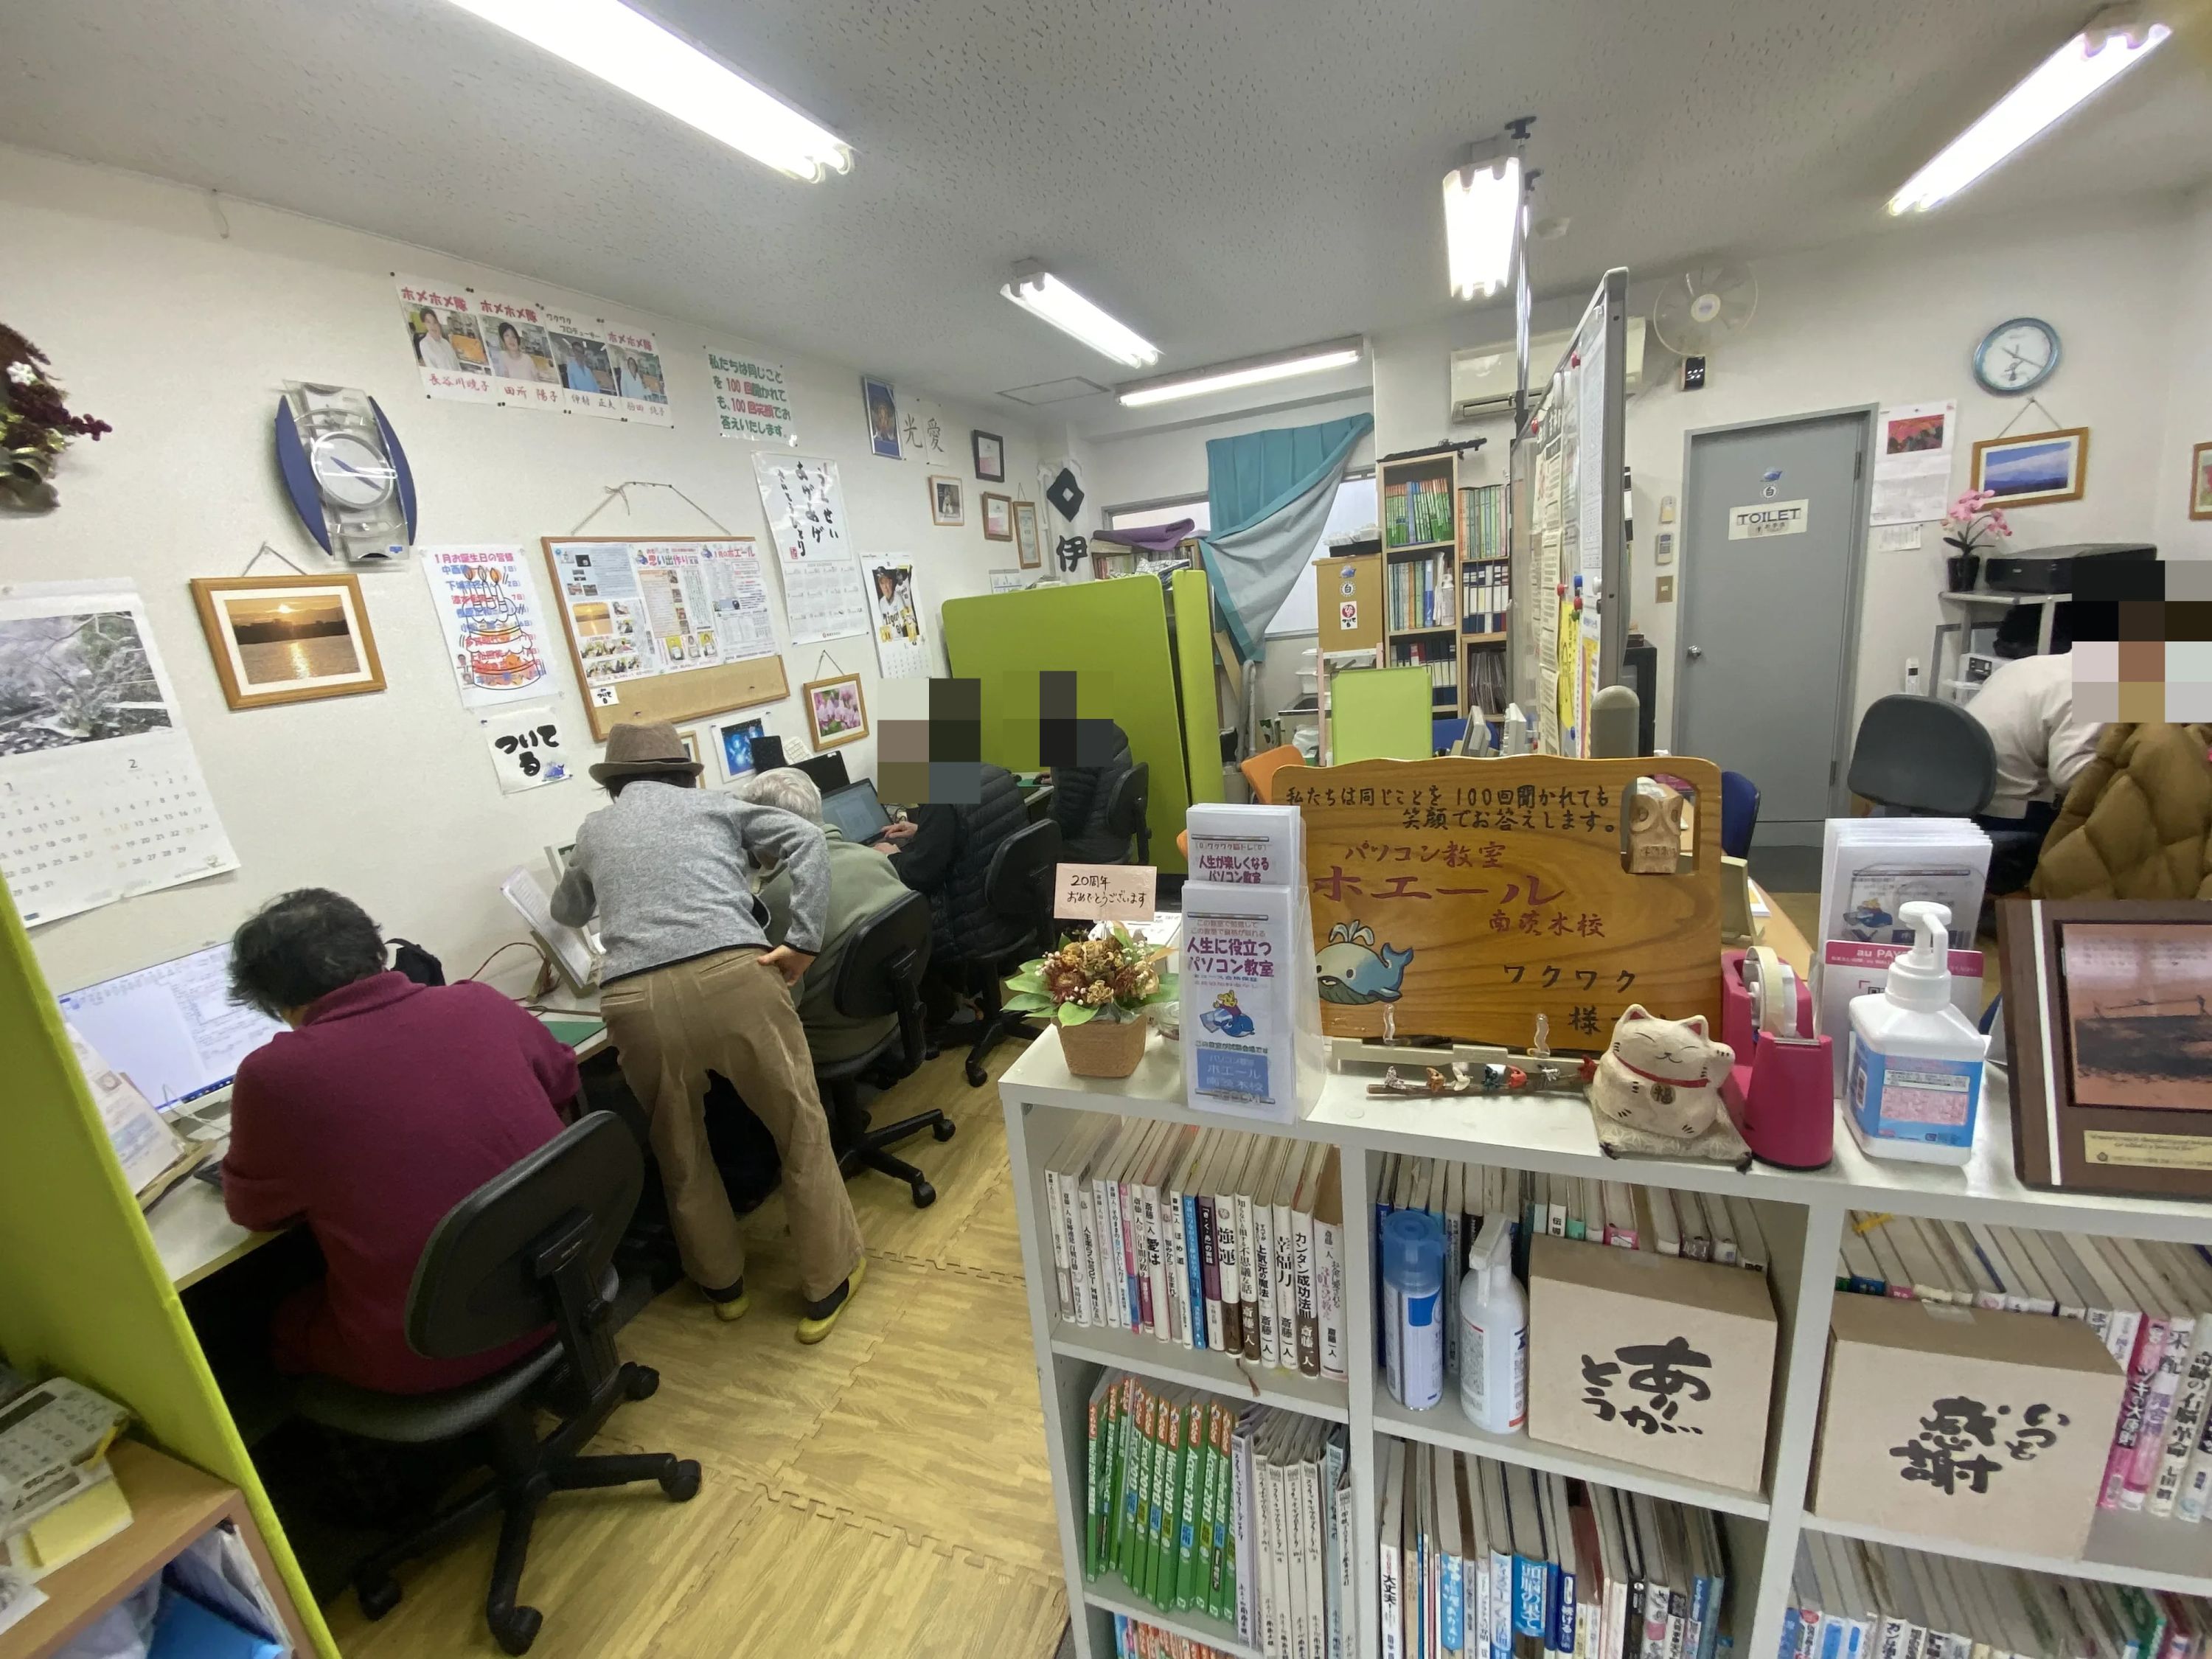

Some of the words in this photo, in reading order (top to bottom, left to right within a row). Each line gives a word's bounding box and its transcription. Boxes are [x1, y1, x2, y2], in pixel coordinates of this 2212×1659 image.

[401, 287, 468, 312] ホメホメ隊
[480, 299, 538, 323] ホメホメ隊
[709, 354, 783, 383] 私たちは同じこと
[903, 413, 922, 448] 光
[927, 417, 944, 452] 愛
[1737, 508, 1801, 526] TOILET
[1056, 535, 1088, 572] 伊
[495, 724, 559, 754] ついて
[128, 759, 138, 768] 2
[519, 751, 540, 776] る
[1402, 808, 1615, 833] 笑顔でお答えします。
[1199, 855, 1269, 870] 人生が楽しくなる
[1344, 841, 1506, 869] パソコン教室
[1071, 875, 1110, 891] 20周年
[1209, 871, 1262, 884] パソコン教室
[1313, 865, 1565, 905] ホエール
[1067, 890, 1147, 908] おめでとうございます
[1489, 911, 1605, 938] 南茨木校
[1187, 936, 1272, 956] 人生に役立つ
[1857, 949, 1872, 958] au
[1188, 956, 1274, 977] パソコン教室
[1503, 965, 1635, 994] ワクワク
[1568, 1005, 1601, 1035] 様
[1208, 1065, 1261, 1079] ホエール
[1147, 1238, 1161, 1266] 愛は
[1175, 1233, 1185, 1265] ほめ道
[1218, 1228, 1236, 1265] 強運
[1237, 1198, 1253, 1295] 知らないと損する不思議な話
[1256, 1245, 1270, 1298] 上気元の魔法
[1276, 1237, 1292, 1287] 幸福力
[1295, 1232, 1312, 1319] カンタン成功法則
[1261, 1316, 1273, 1355] 斎藤一人
[1281, 1317, 1294, 1358] 斎藤一人
[1141, 1436, 1152, 1470] Excel
[1154, 1441, 1166, 1477] Word
[1166, 1450, 1178, 1484] Word
[1185, 1446, 1198, 1490] Access
[1205, 1444, 1217, 1490] Access
[1182, 1489, 1194, 1523] 2013
[1203, 1488, 1213, 1523] 2013
